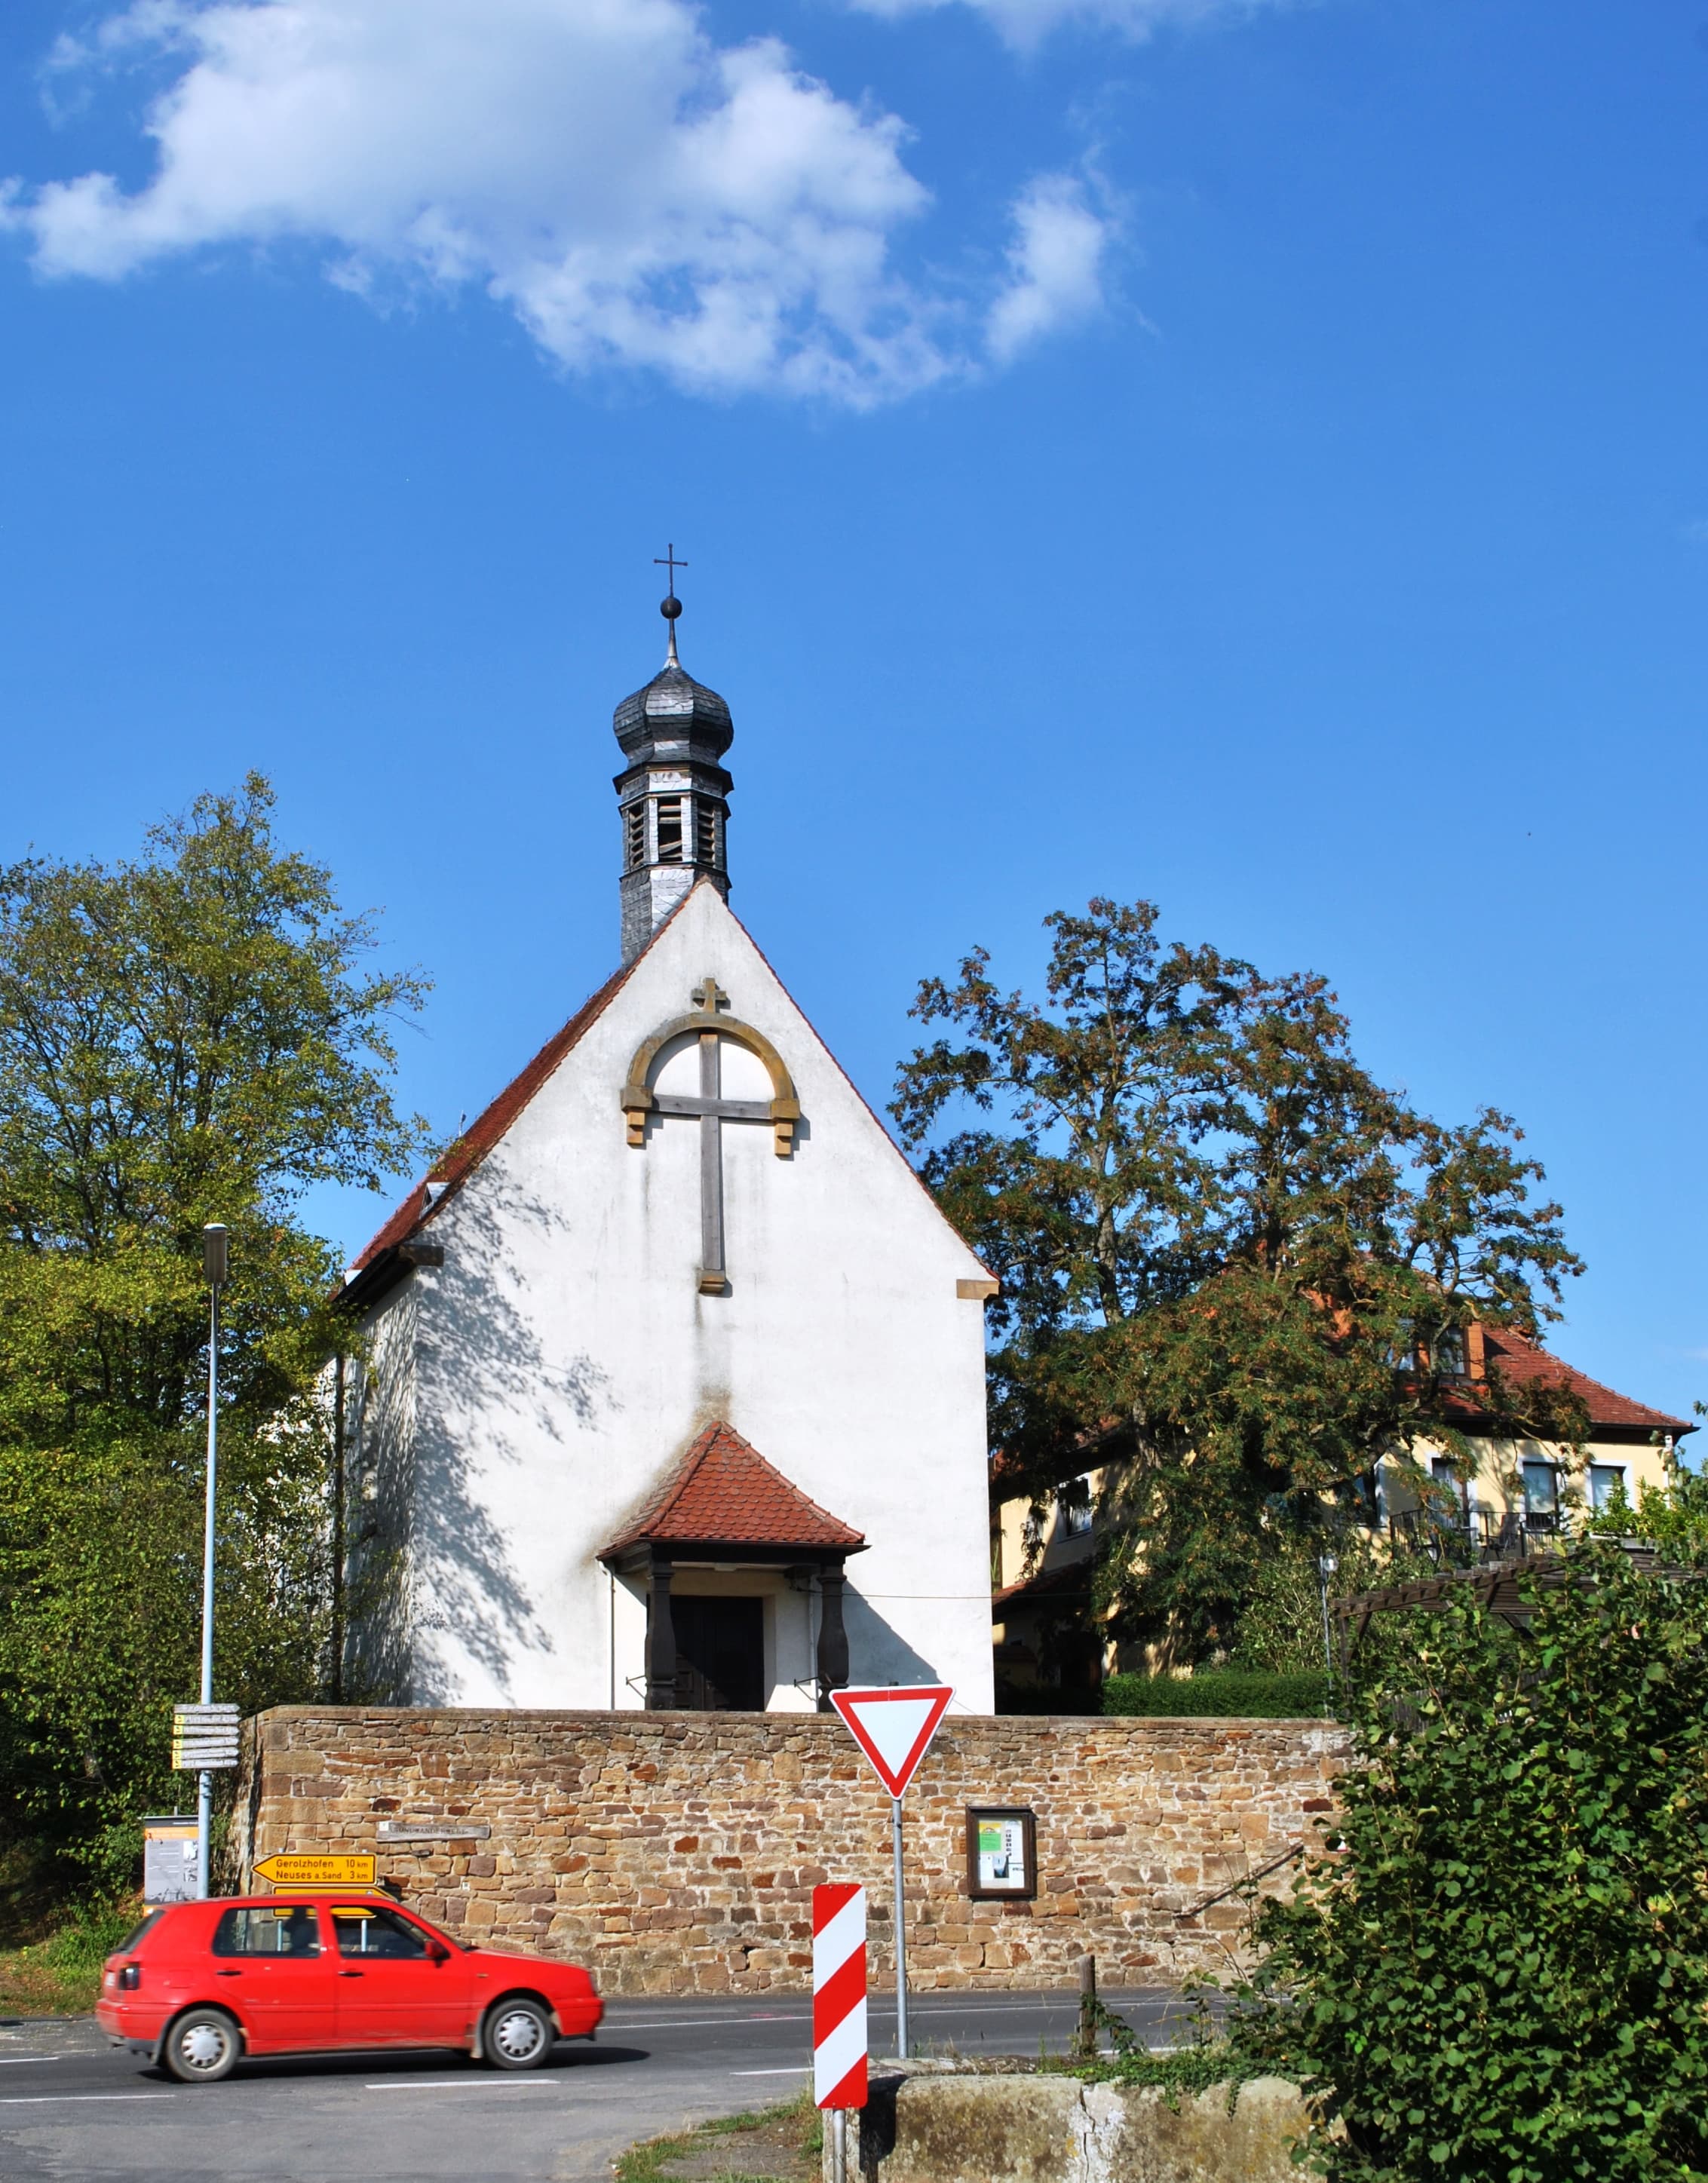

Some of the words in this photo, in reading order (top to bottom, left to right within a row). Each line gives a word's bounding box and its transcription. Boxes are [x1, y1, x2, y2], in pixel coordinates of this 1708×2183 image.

[276, 1859, 334, 1868] Gerolzhofen
[345, 1859, 355, 1868] 10
[276, 1870, 312, 1879] Neuses
[349, 1870, 355, 1879] 3
